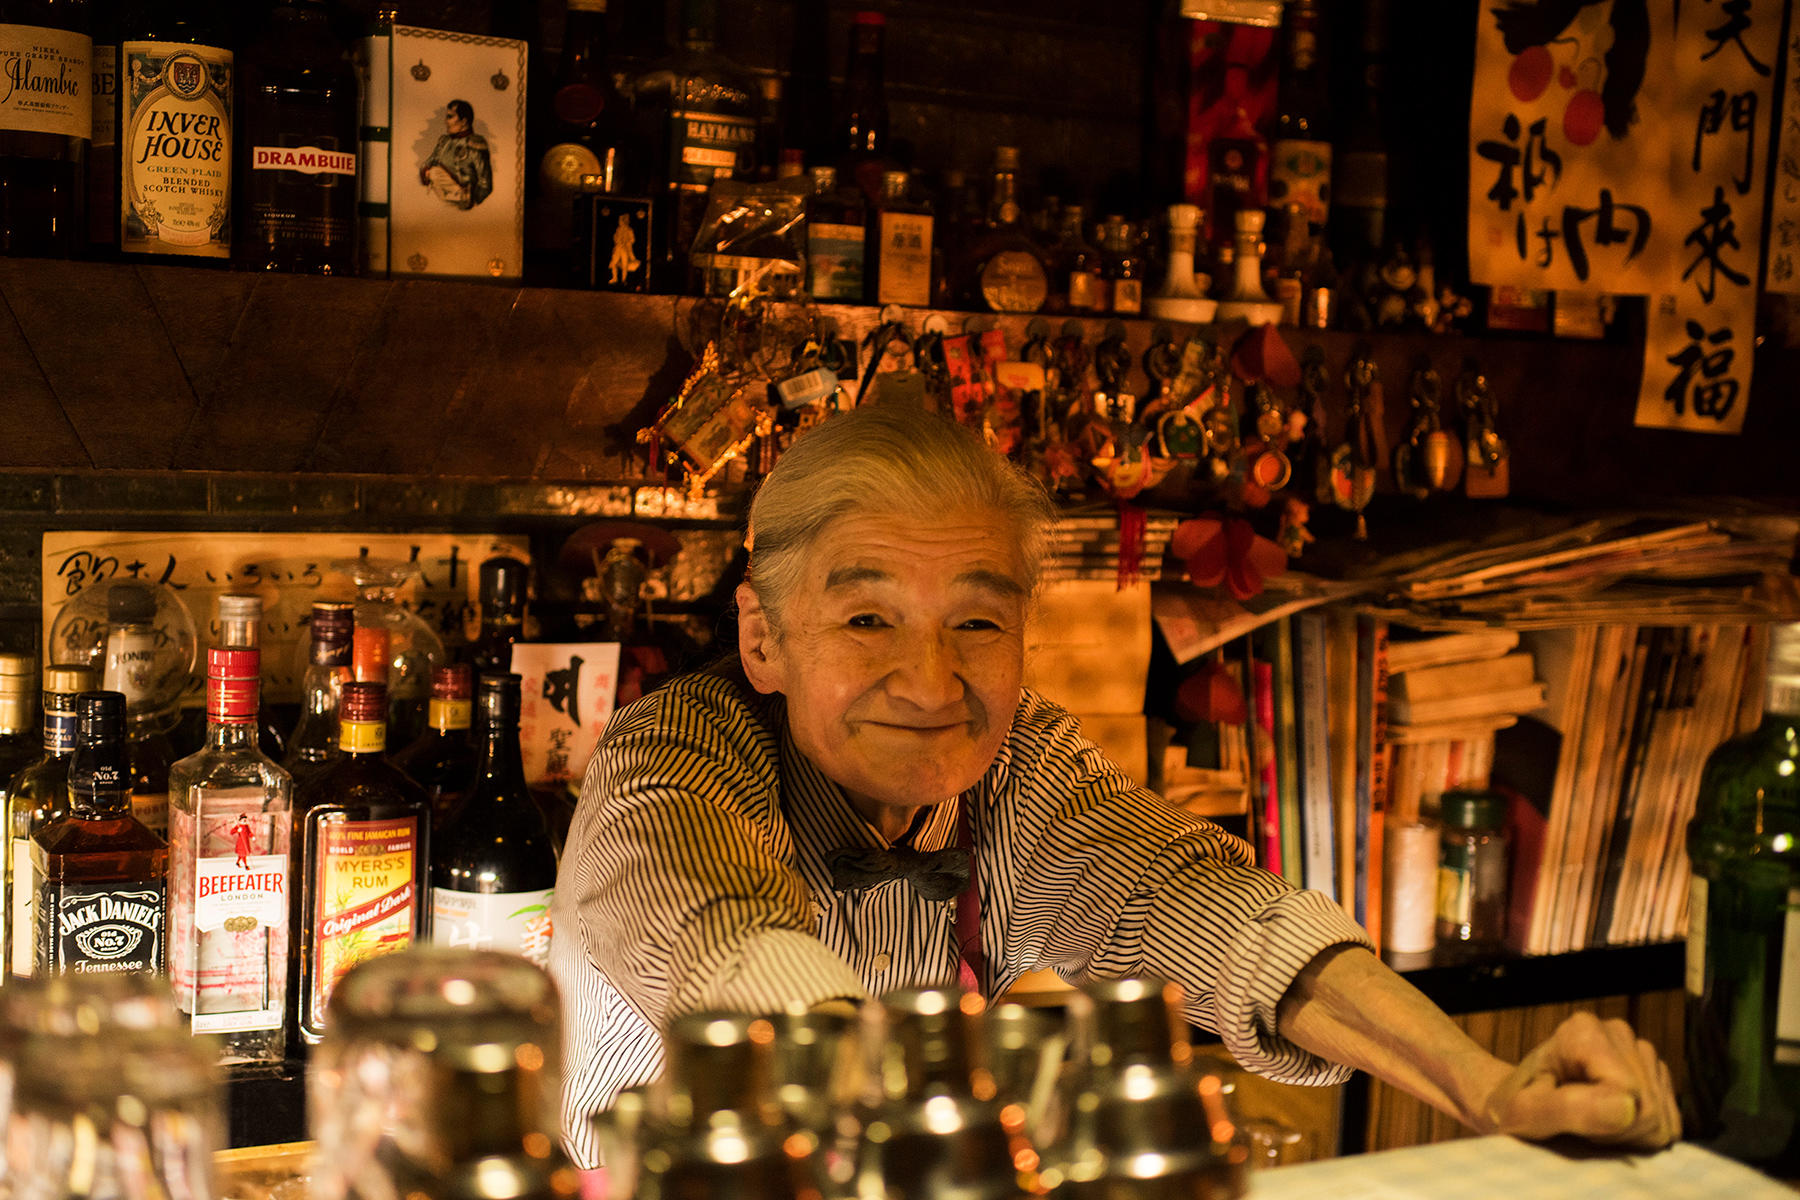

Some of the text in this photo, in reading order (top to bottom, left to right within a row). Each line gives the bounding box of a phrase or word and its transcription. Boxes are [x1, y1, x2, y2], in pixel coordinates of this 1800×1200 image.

[1, 57, 79, 104] Alambic
[146, 111, 222, 140] INVER
[136, 133, 223, 164] HOUSE
[257, 151, 354, 171] DRAMBUIE
[147, 165, 222, 178] GREEN PLAID
[143, 184, 186, 194] SCOTCH
[163, 177, 210, 187] BLENDED
[93, 771, 119, 781] No.7
[347, 831, 364, 841] FINE
[365, 829, 397, 840] JAMAICAN
[329, 842, 411, 854] WORLD FAMOUS
[335, 856, 405, 873] MYERS'S
[199, 873, 283, 898] BEEFEATER
[352, 875, 388, 889] RUM
[220, 893, 264, 902] LONDON
[58, 896, 162, 936] JACK DANIEL'S
[323, 902, 380, 936] Original
[381, 886, 411, 913] Dark
[93, 936, 125, 948] No.7
[74, 959, 143, 975] Tennessee
